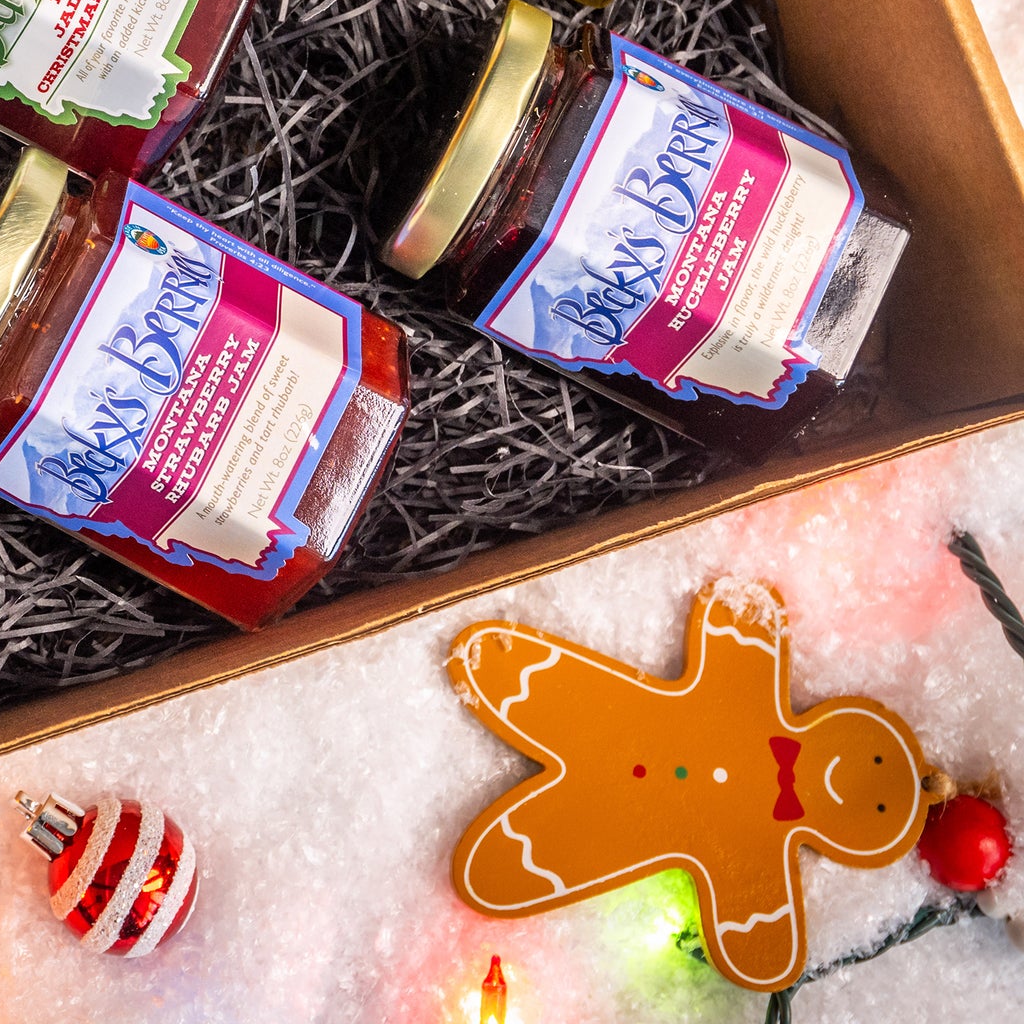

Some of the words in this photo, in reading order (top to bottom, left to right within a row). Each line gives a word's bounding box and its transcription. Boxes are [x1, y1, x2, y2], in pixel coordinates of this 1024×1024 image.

[75, 68, 89, 82] All
[82, 57, 95, 71] of
[90, 42, 106, 64] your
[99, 2, 127, 42] favorite
[210, 230, 235, 247] heart
[235, 244, 257, 259] with
[769, 173, 808, 236] huckleberry
[209, 237, 247, 260] Proverbs
[548, 224, 666, 345] Becky's
[665, 190, 727, 306] MONTANA
[667, 168, 756, 332] HUCKLEBERRY
[714, 236, 746, 291] JAM
[750, 259, 766, 280] the
[758, 235, 776, 260] wild
[729, 315, 741, 328] in
[733, 280, 758, 315] flavor,
[35, 385, 147, 503] Becky's
[96, 249, 224, 394] Berries
[701, 327, 734, 360] Explosive
[141, 353, 212, 473] MONTANA
[149, 332, 240, 493] STRAWBERRY
[165, 395, 231, 504] RHUBARB
[224, 338, 260, 393] JAM
[195, 510, 206, 520] A
[201, 433, 252, 515] mouth-watering
[243, 399, 266, 433] blend
[261, 385, 272, 401] of
[267, 353, 290, 388] sweet
[213, 465, 252, 526] strawberries
[247, 441, 264, 465] and
[257, 419, 275, 442] tart
[269, 370, 300, 419] rhubarb!
